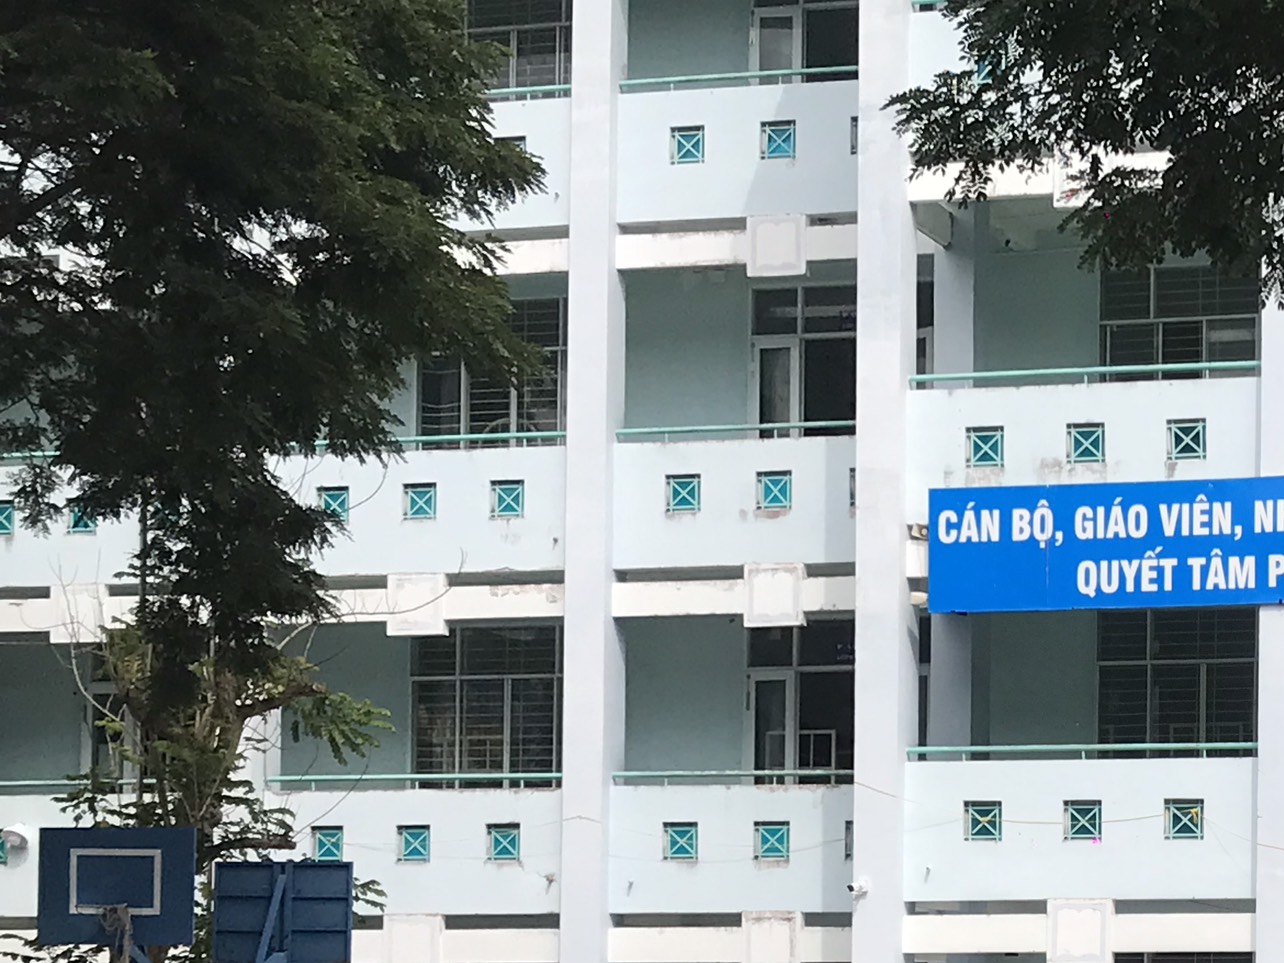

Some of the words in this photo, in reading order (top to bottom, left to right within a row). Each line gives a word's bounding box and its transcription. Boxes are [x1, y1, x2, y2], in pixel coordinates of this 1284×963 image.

[938, 501, 1000, 544] CÁN
[1012, 499, 1063, 549] BỘ,
[1074, 496, 1148, 540] GIÁO
[1159, 494, 1242, 542] VIÊN,
[1077, 546, 1178, 597] QUYẾT
[1187, 548, 1256, 591] TÂM
